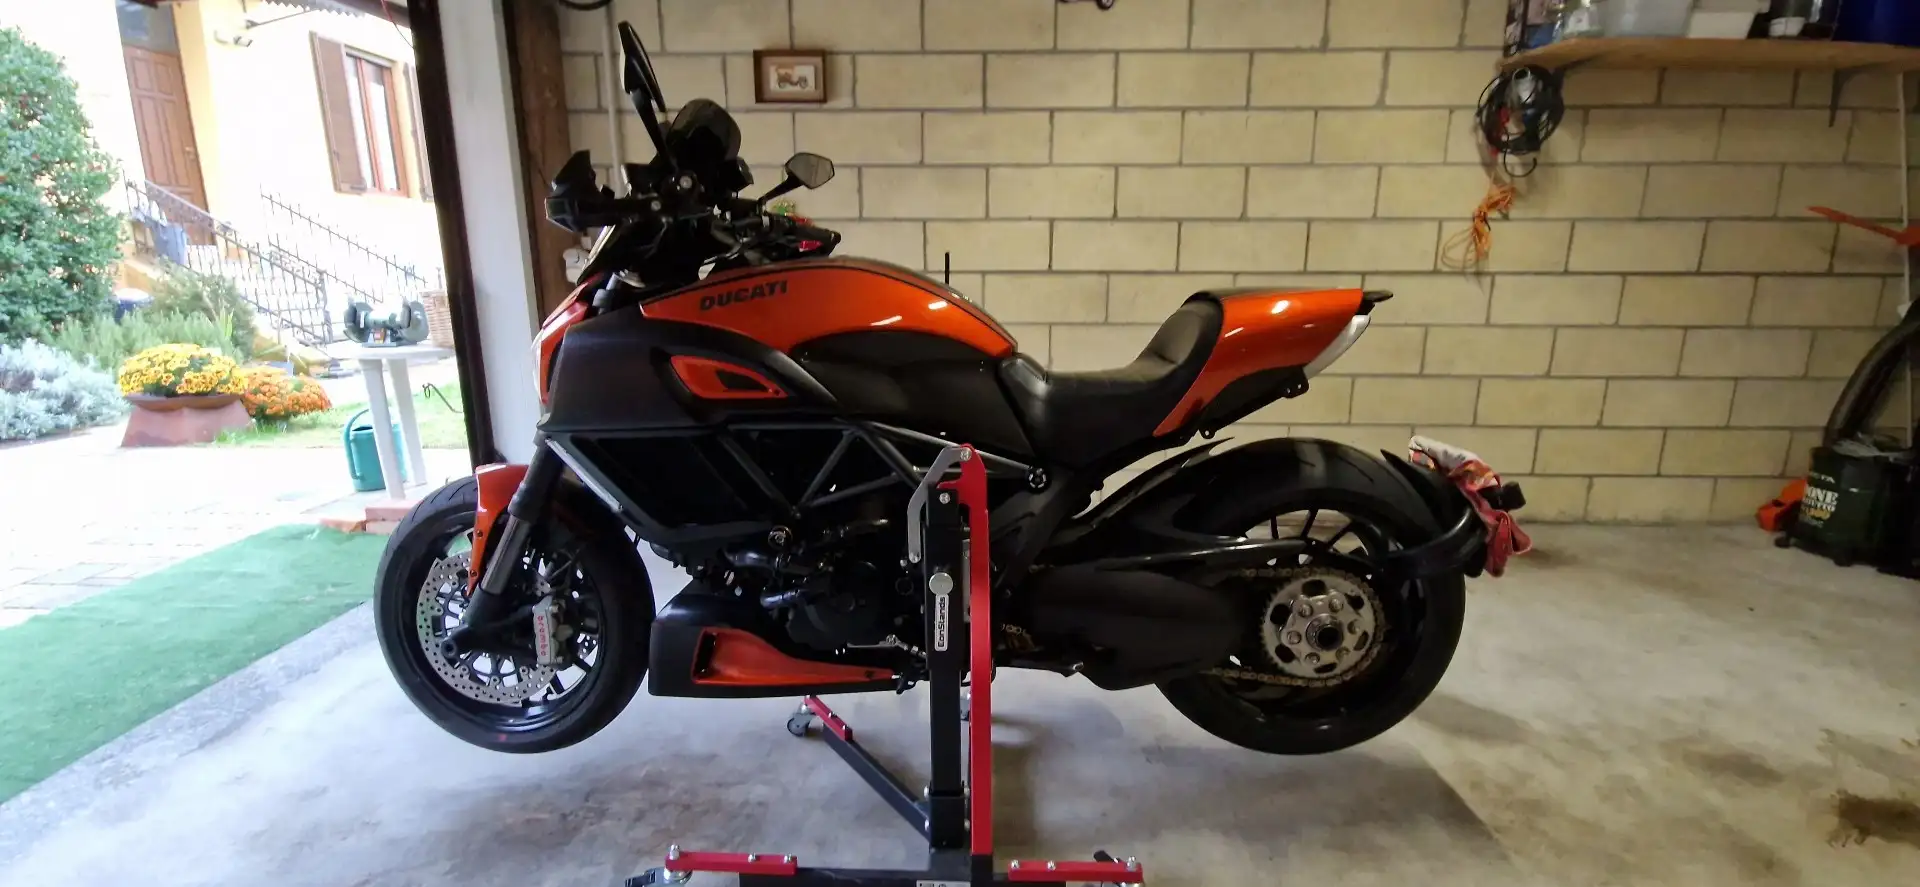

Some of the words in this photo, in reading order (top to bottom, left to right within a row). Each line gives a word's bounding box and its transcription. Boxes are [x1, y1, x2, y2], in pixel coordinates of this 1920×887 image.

[700, 280, 788, 310] DUCATI
[537, 615, 548, 657] brembo
[937, 596, 946, 648] EonStands
